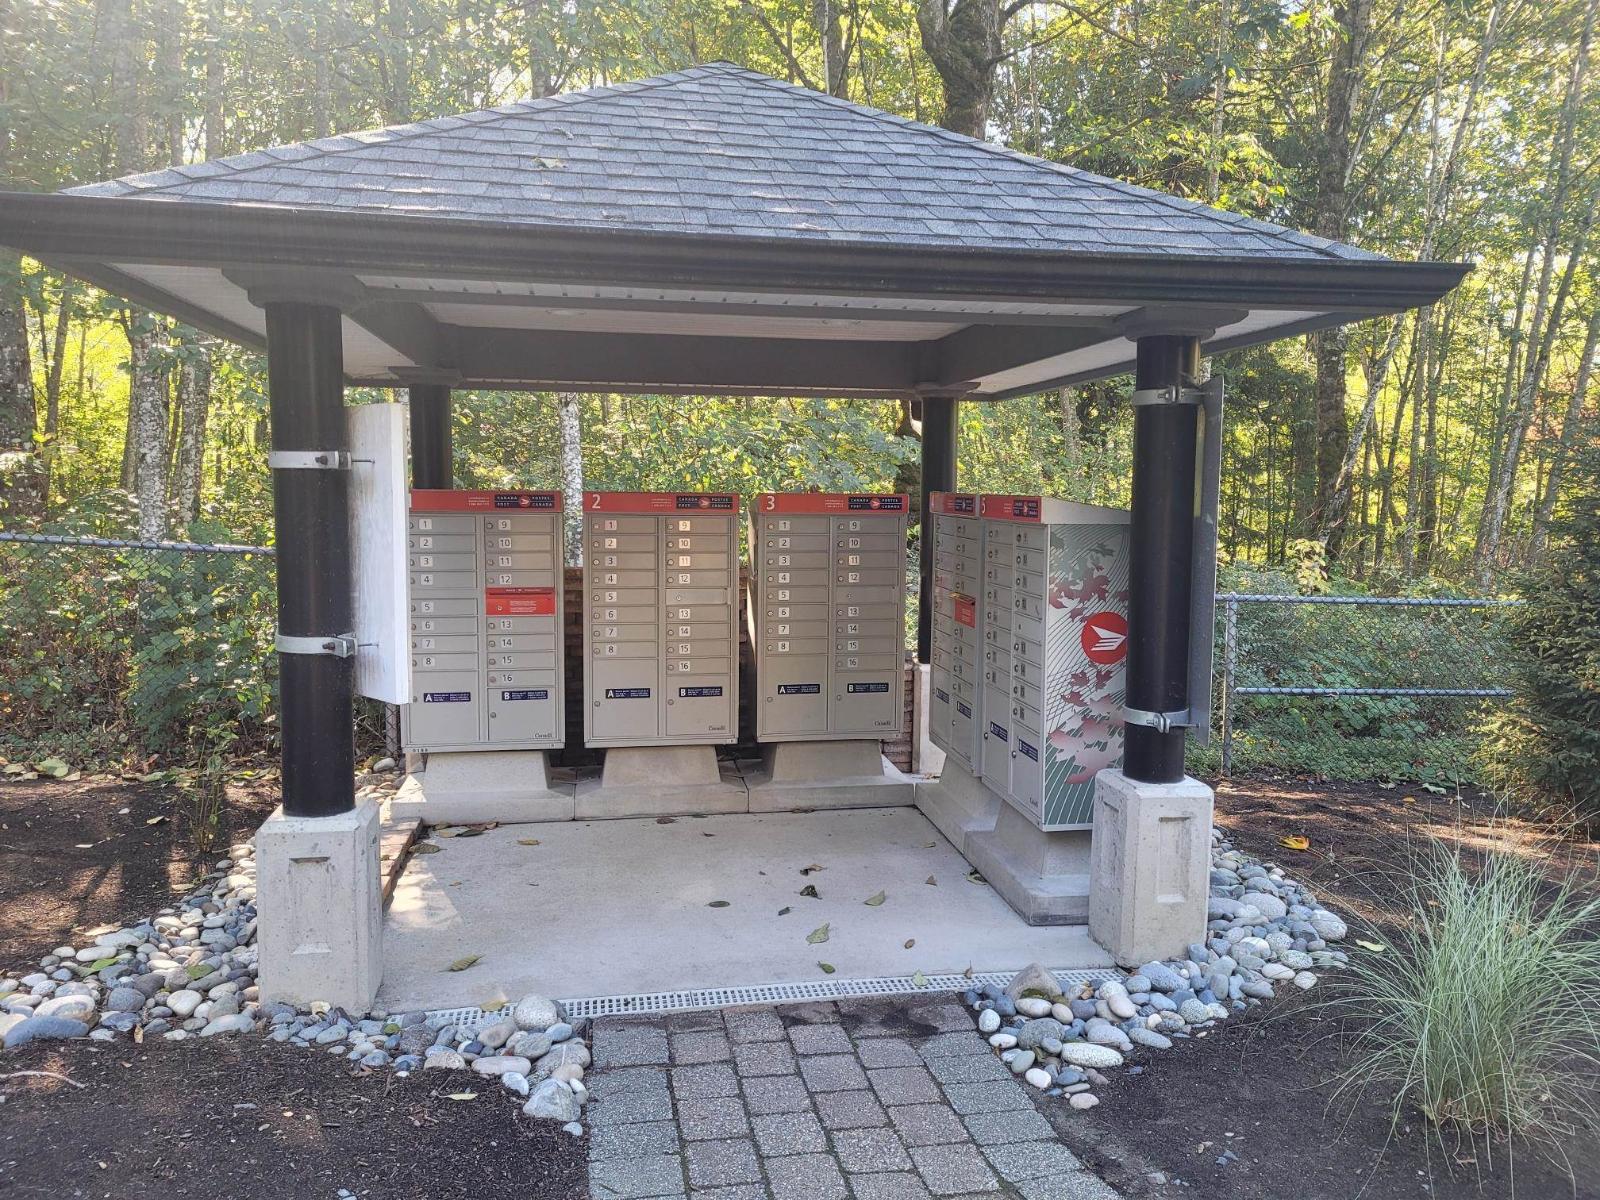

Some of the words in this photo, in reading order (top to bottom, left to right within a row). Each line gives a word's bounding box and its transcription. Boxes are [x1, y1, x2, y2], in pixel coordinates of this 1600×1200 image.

[592, 493, 601, 508] 2
[766, 495, 775, 510] 3
[423, 538, 429, 546] 2
[681, 539, 689, 547] 10
[423, 557, 429, 565] 3
[851, 556, 858, 564] 11
[424, 575, 429, 583] 4
[501, 575, 511, 583] 12
[680, 574, 689, 582] 12
[680, 609, 689, 617] 13
[849, 607, 858, 615] 13
[425, 621, 430, 629] 6
[501, 620, 511, 628] 13
[849, 624, 857, 632] 14
[609, 628, 614, 636] 7
[680, 627, 689, 635] 14
[502, 638, 512, 646] 14
[780, 642, 786, 650] 8
[849, 641, 857, 649] 15
[608, 645, 614, 653] 8
[680, 644, 689, 652] 15
[425, 657, 431, 665] 8
[680, 688, 686, 696] B
[848, 684, 854, 692] B
[504, 692, 510, 700] B
[607, 689, 614, 697] A
[425, 694, 432, 702] A
